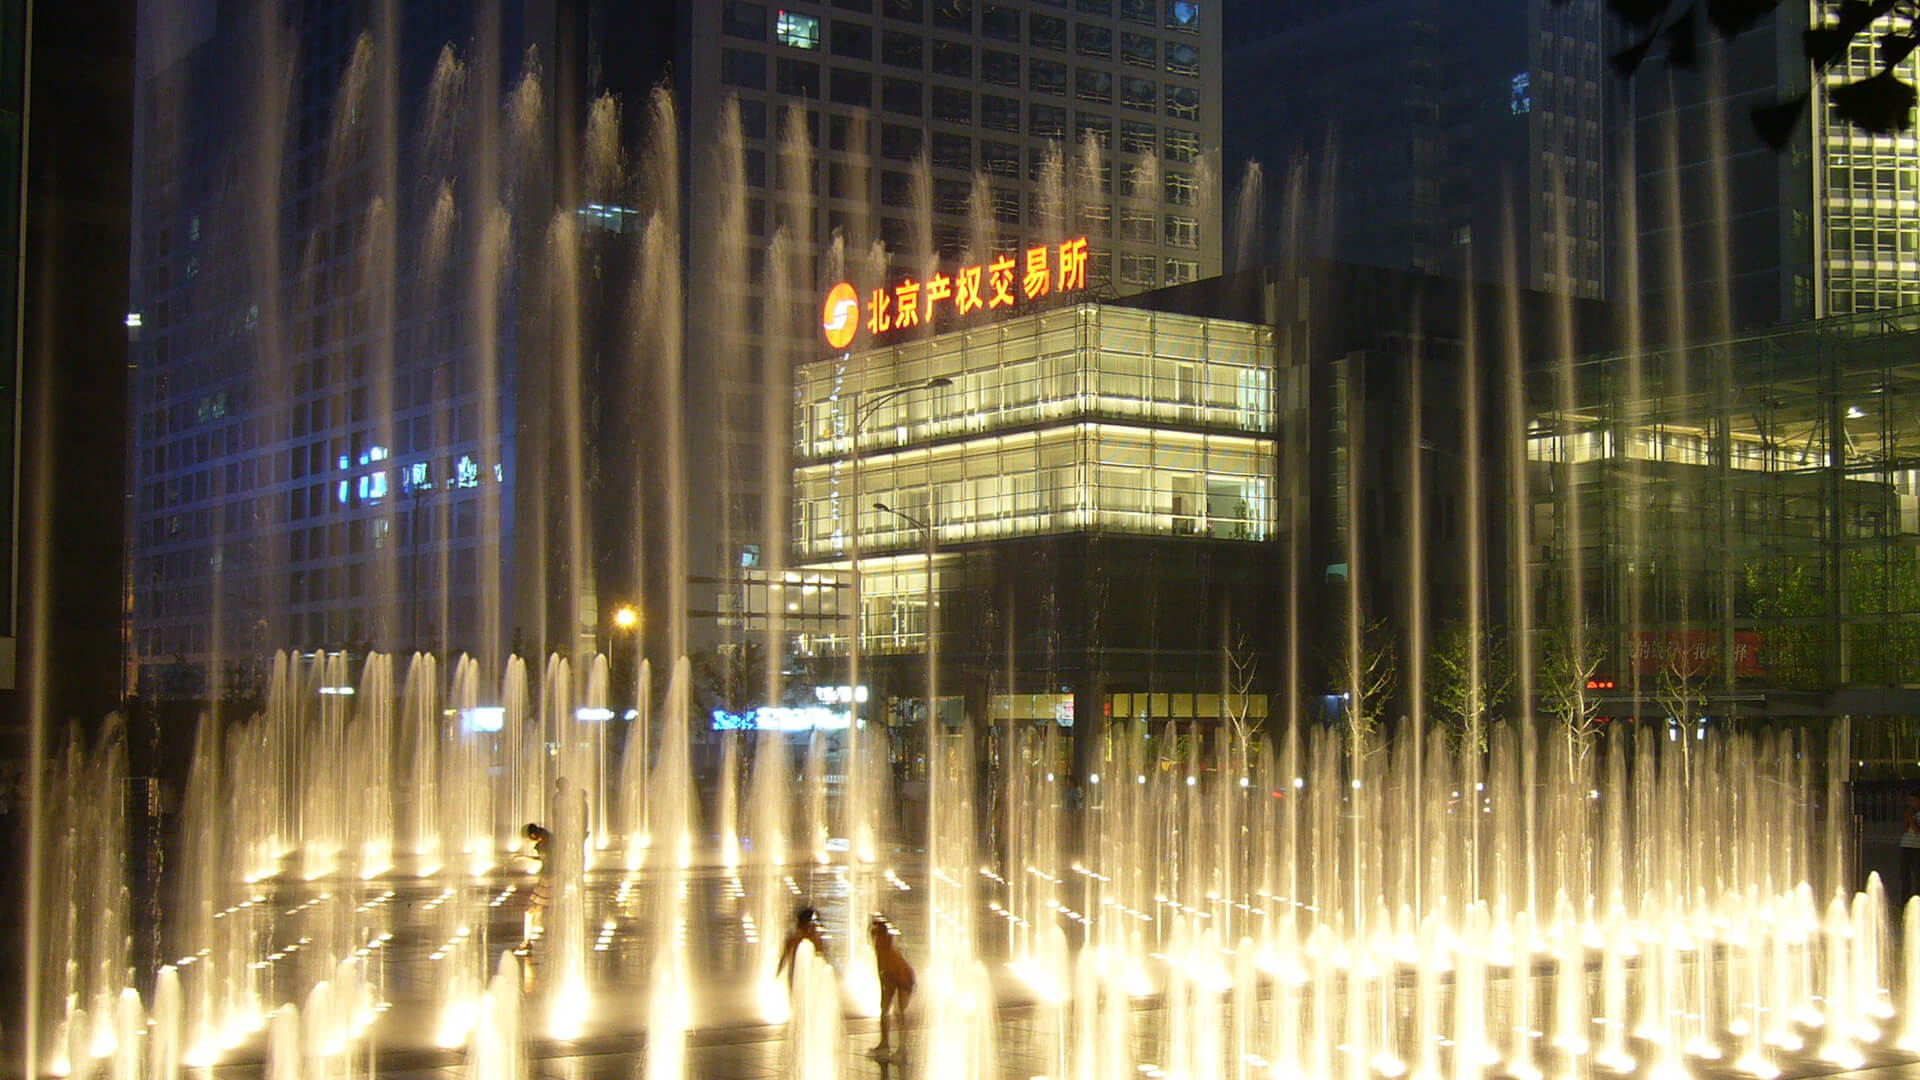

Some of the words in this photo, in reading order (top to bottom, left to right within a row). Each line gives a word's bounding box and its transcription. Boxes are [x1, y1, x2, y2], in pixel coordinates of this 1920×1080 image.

[867, 237, 1088, 334] 北京产权交易所
